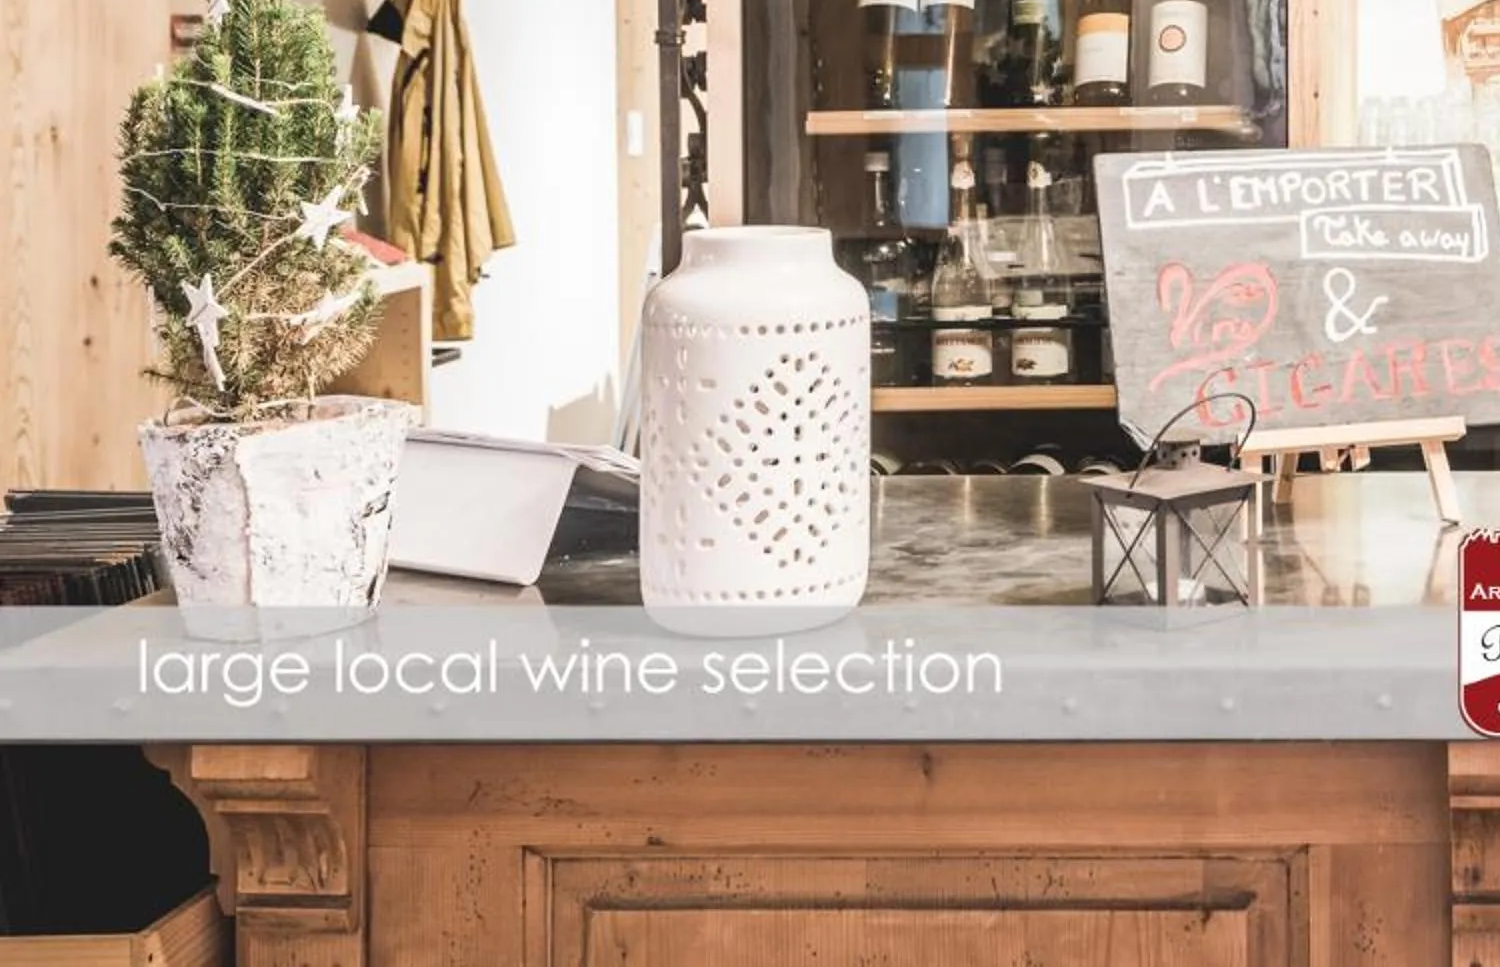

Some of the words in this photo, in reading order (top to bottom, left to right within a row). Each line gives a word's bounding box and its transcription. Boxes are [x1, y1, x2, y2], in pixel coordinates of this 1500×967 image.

[1142, 181, 1176, 218] A
[1199, 167, 1441, 214] L'EMPORTER
[1313, 214, 1390, 249] Take
[1398, 228, 1470, 258] away
[1323, 266, 1389, 343] &
